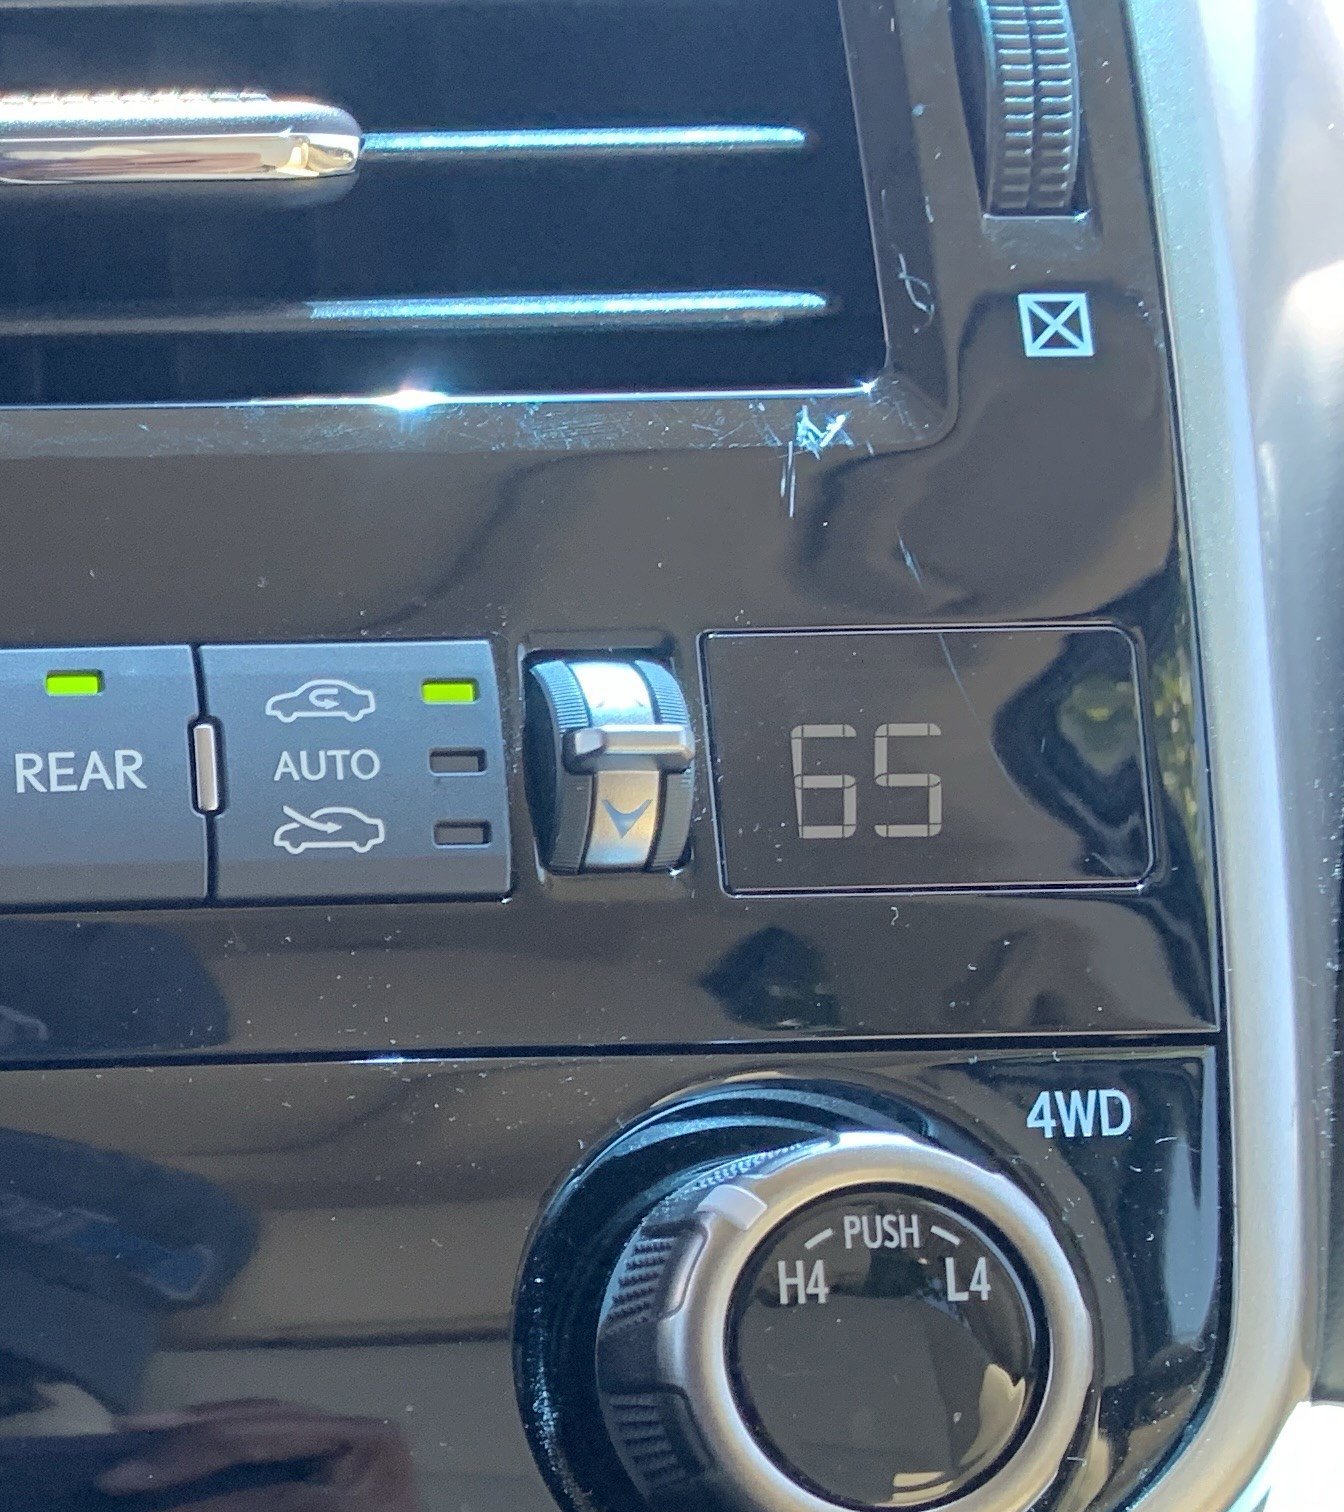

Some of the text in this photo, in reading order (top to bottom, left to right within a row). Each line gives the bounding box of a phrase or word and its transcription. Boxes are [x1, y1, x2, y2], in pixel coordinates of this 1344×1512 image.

[14, 749, 147, 793] REAR
[273, 748, 381, 781] AUTO
[790, 722, 942, 839] 65
[1026, 1088, 1132, 1139] 4WD
[843, 1214, 920, 1249] PUSH
[777, 1259, 829, 1305] H4
[945, 1256, 992, 1302] L4
